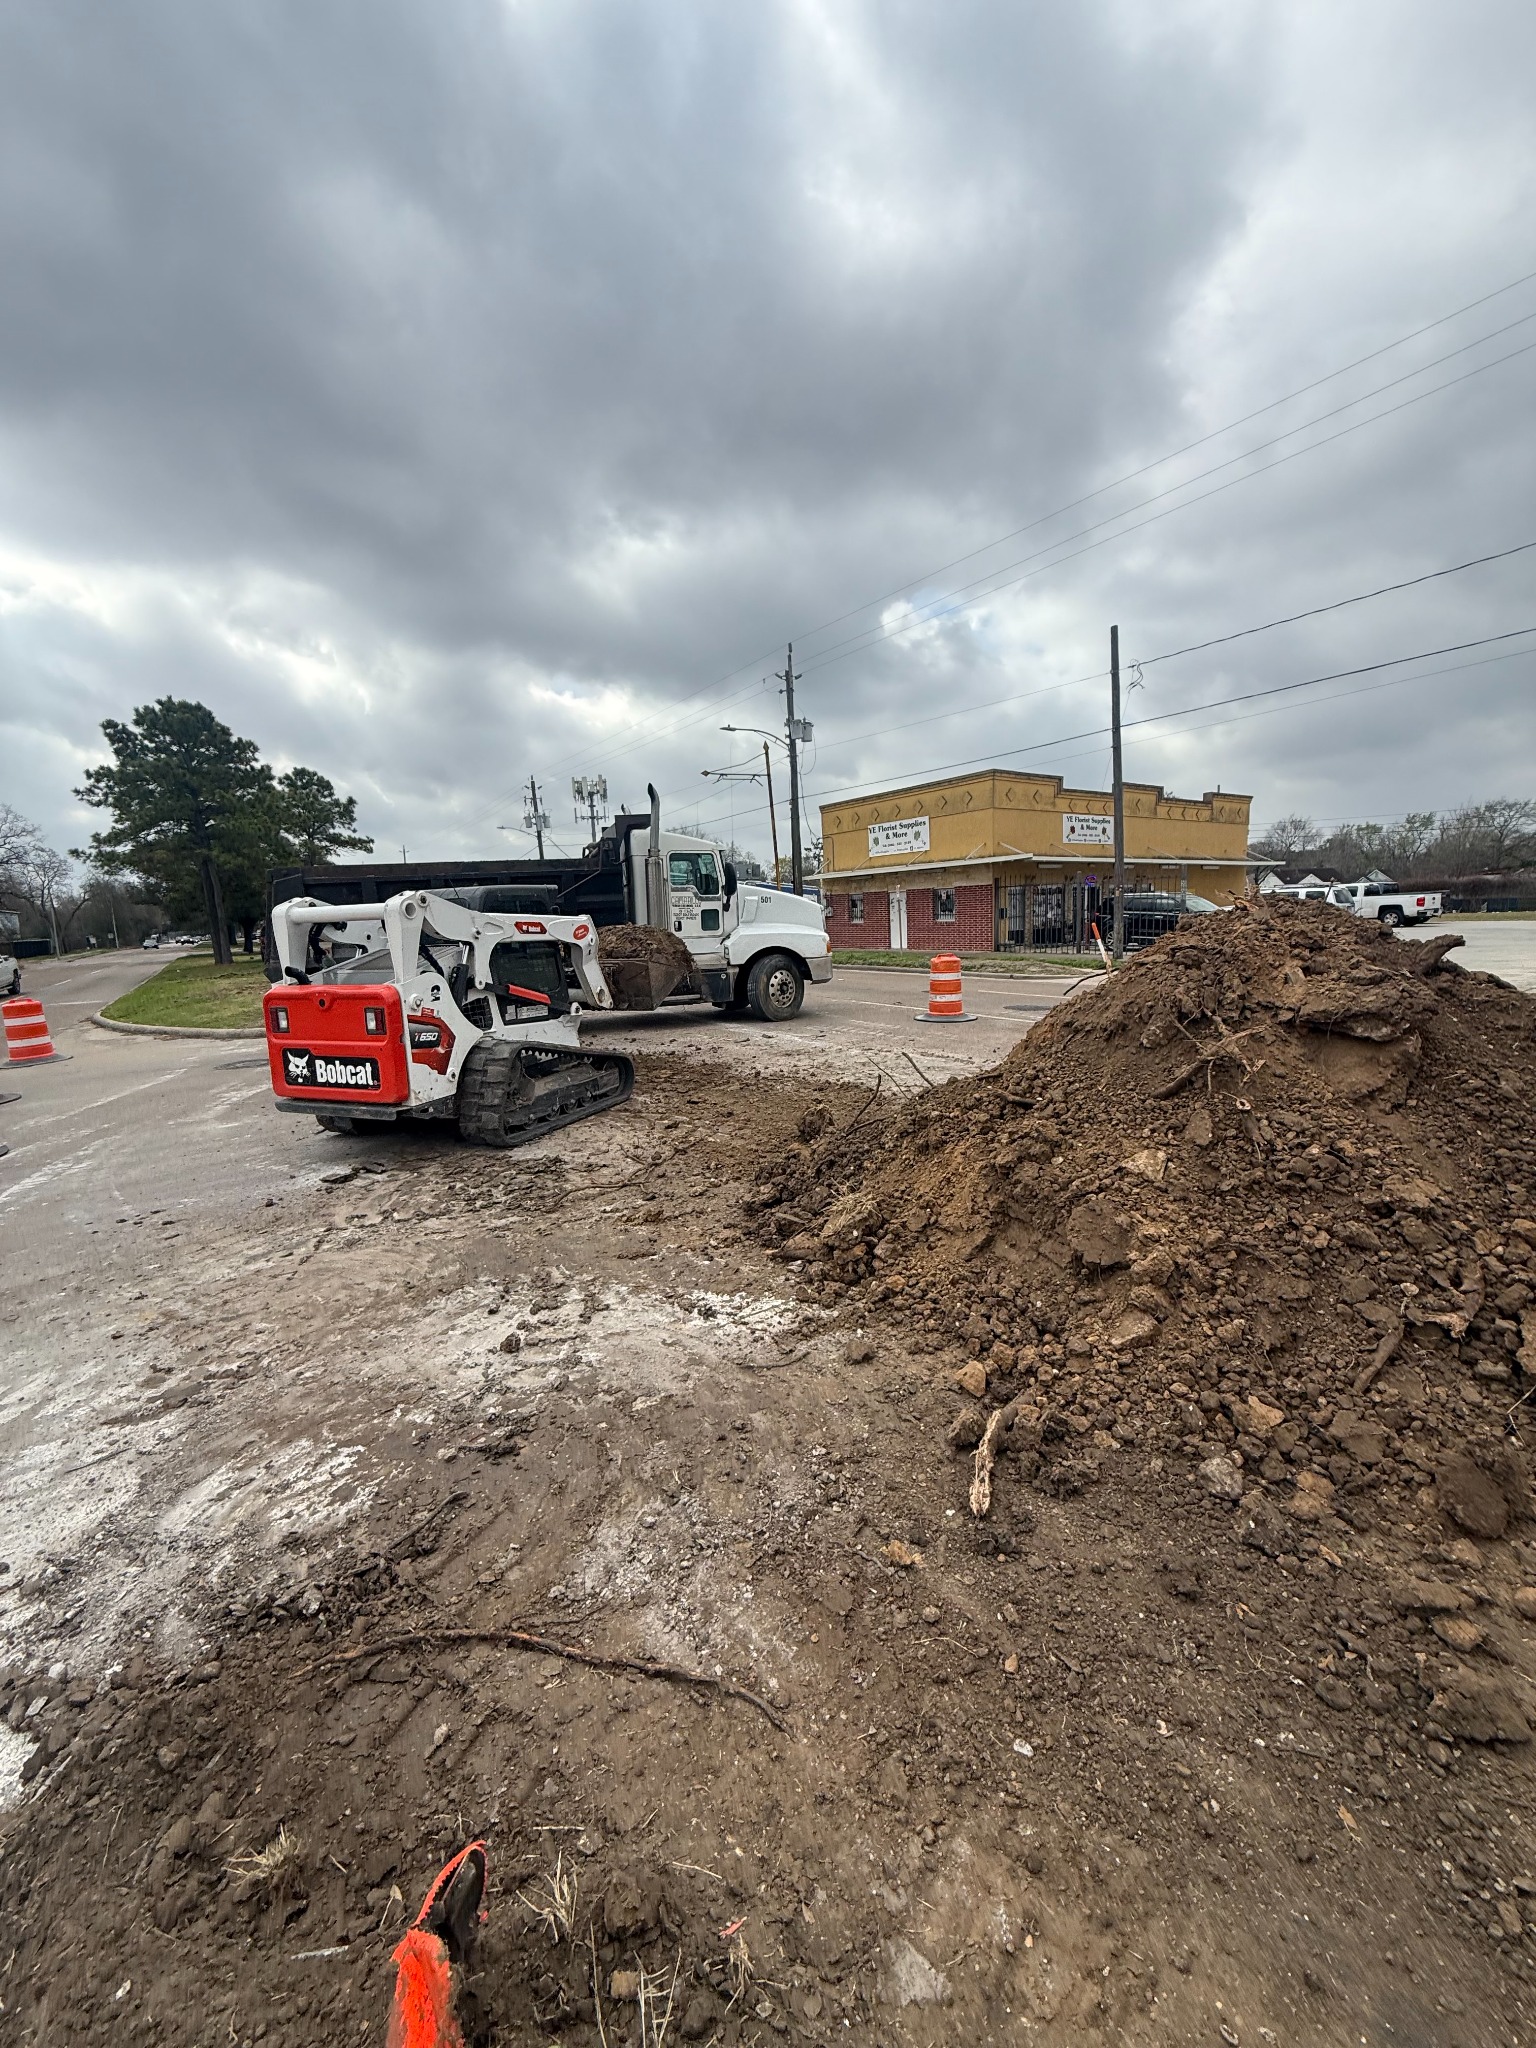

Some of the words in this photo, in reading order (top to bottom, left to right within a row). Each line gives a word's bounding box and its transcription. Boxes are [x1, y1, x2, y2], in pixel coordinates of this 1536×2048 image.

[878, 824, 897, 832] Florist
[898, 820, 926, 830] Supplies
[760, 896, 772, 904] 501
[414, 1032, 439, 1042] T650
[315, 1060, 374, 1086] Bobcat
